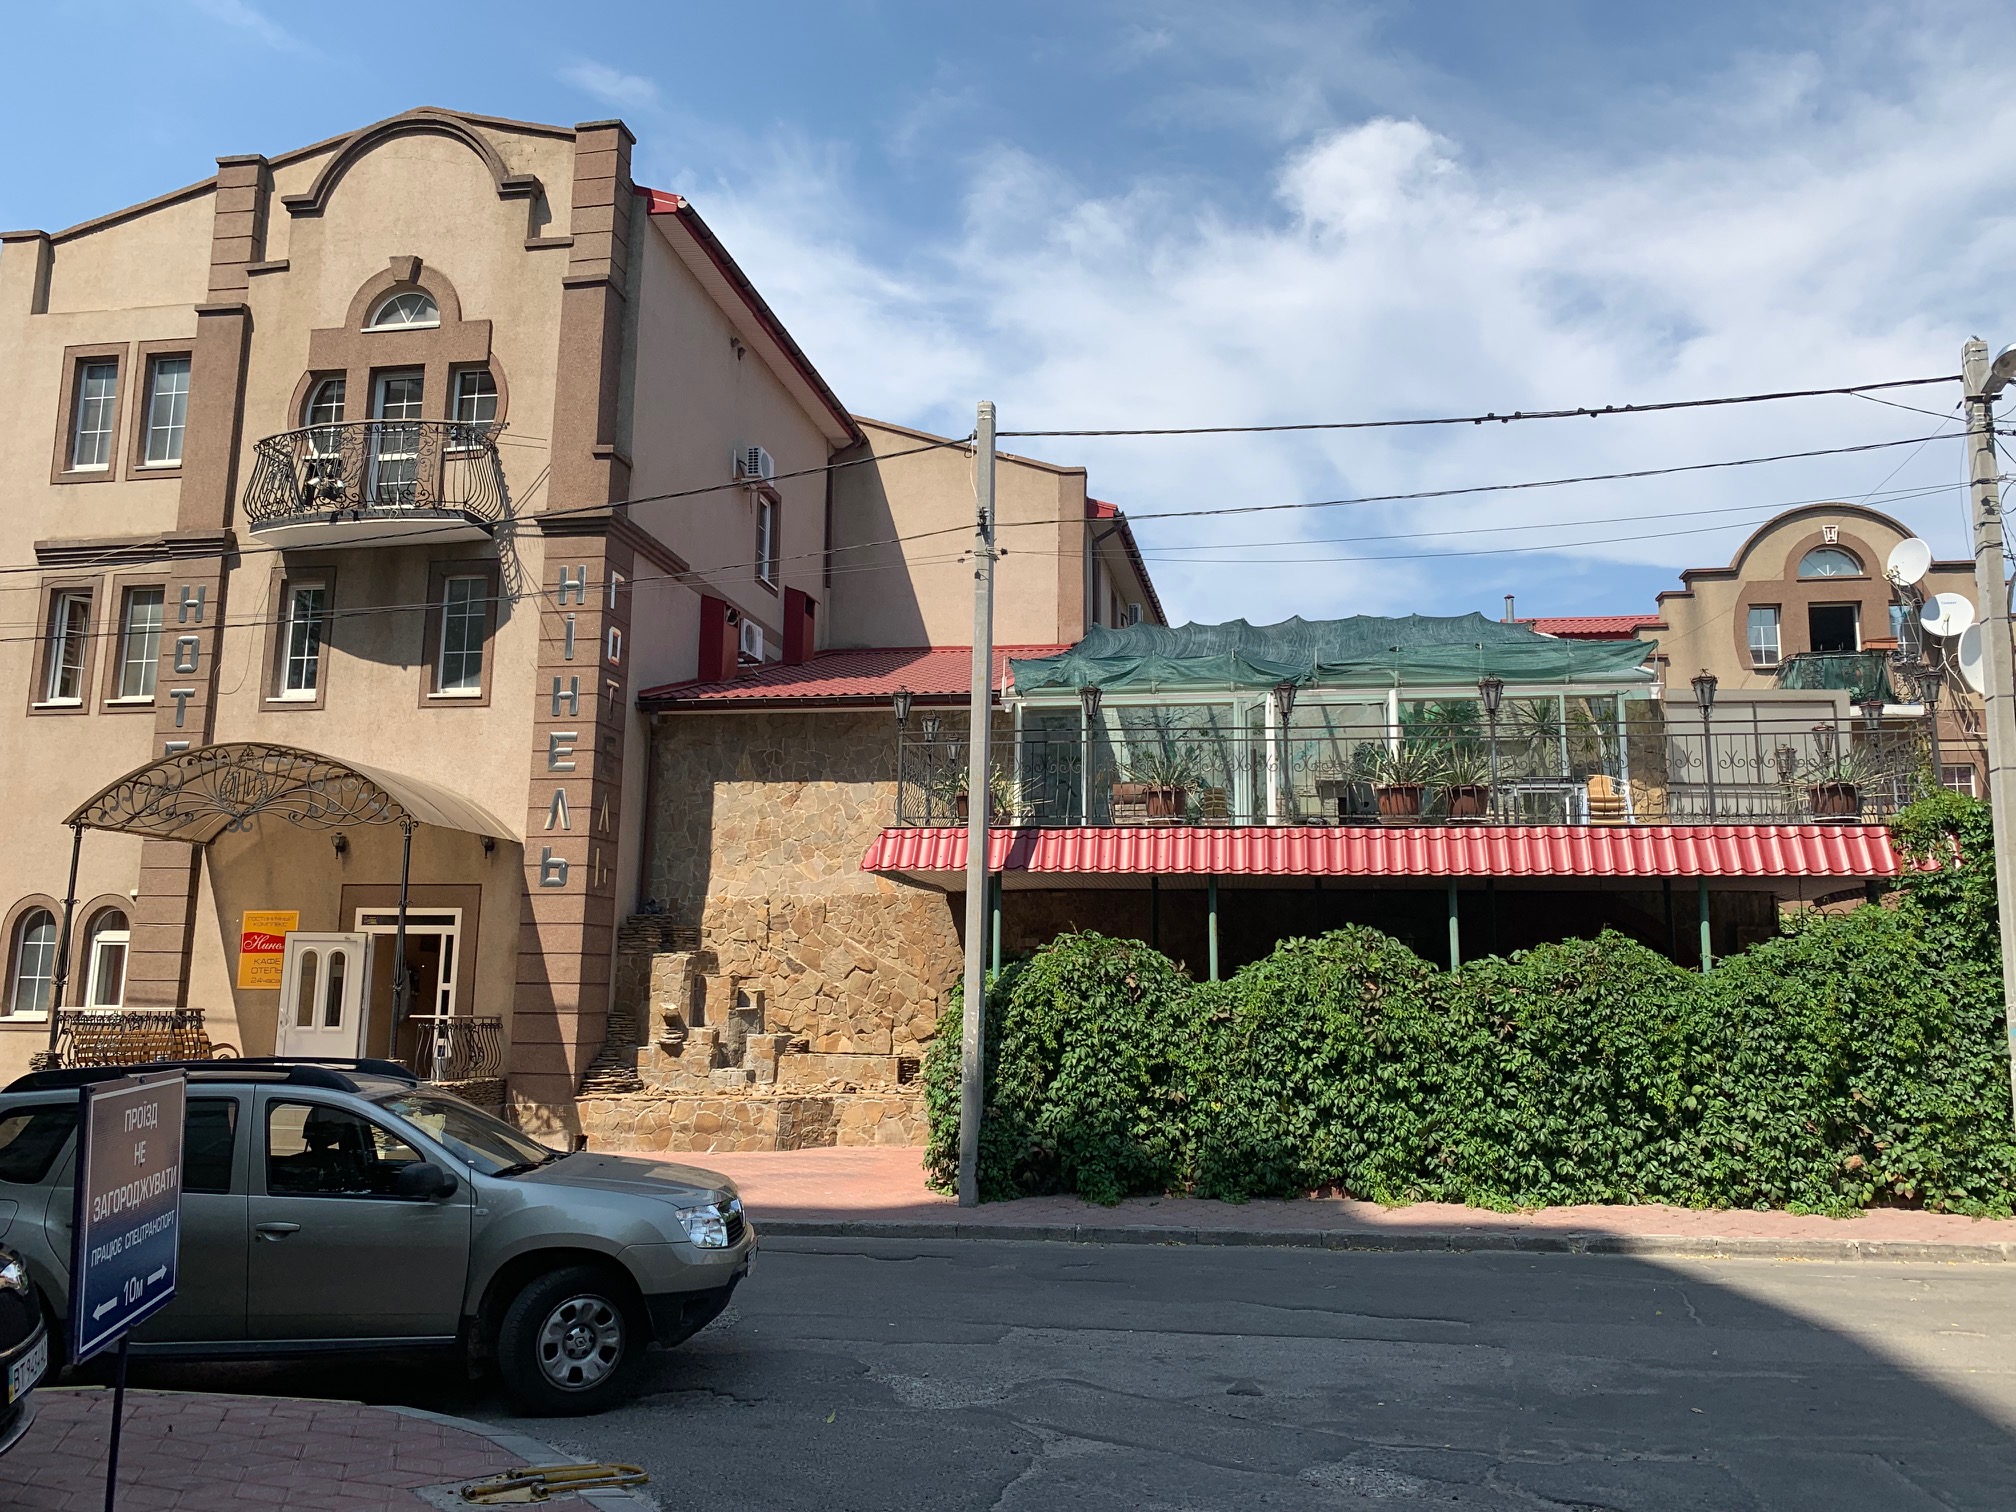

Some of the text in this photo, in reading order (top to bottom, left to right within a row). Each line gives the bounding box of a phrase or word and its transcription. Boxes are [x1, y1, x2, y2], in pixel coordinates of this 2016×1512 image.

[244, 934, 284, 950] Нине
[124, 1101, 158, 1133] ПРОЇЗД
[133, 1140, 147, 1166] НЕ
[93, 1165, 177, 1223] ЗАГОРОДЖУВАТИ
[91, 1209, 175, 1268] ПРАЦЮЄ СПЕЦТРАНСПОРТ
